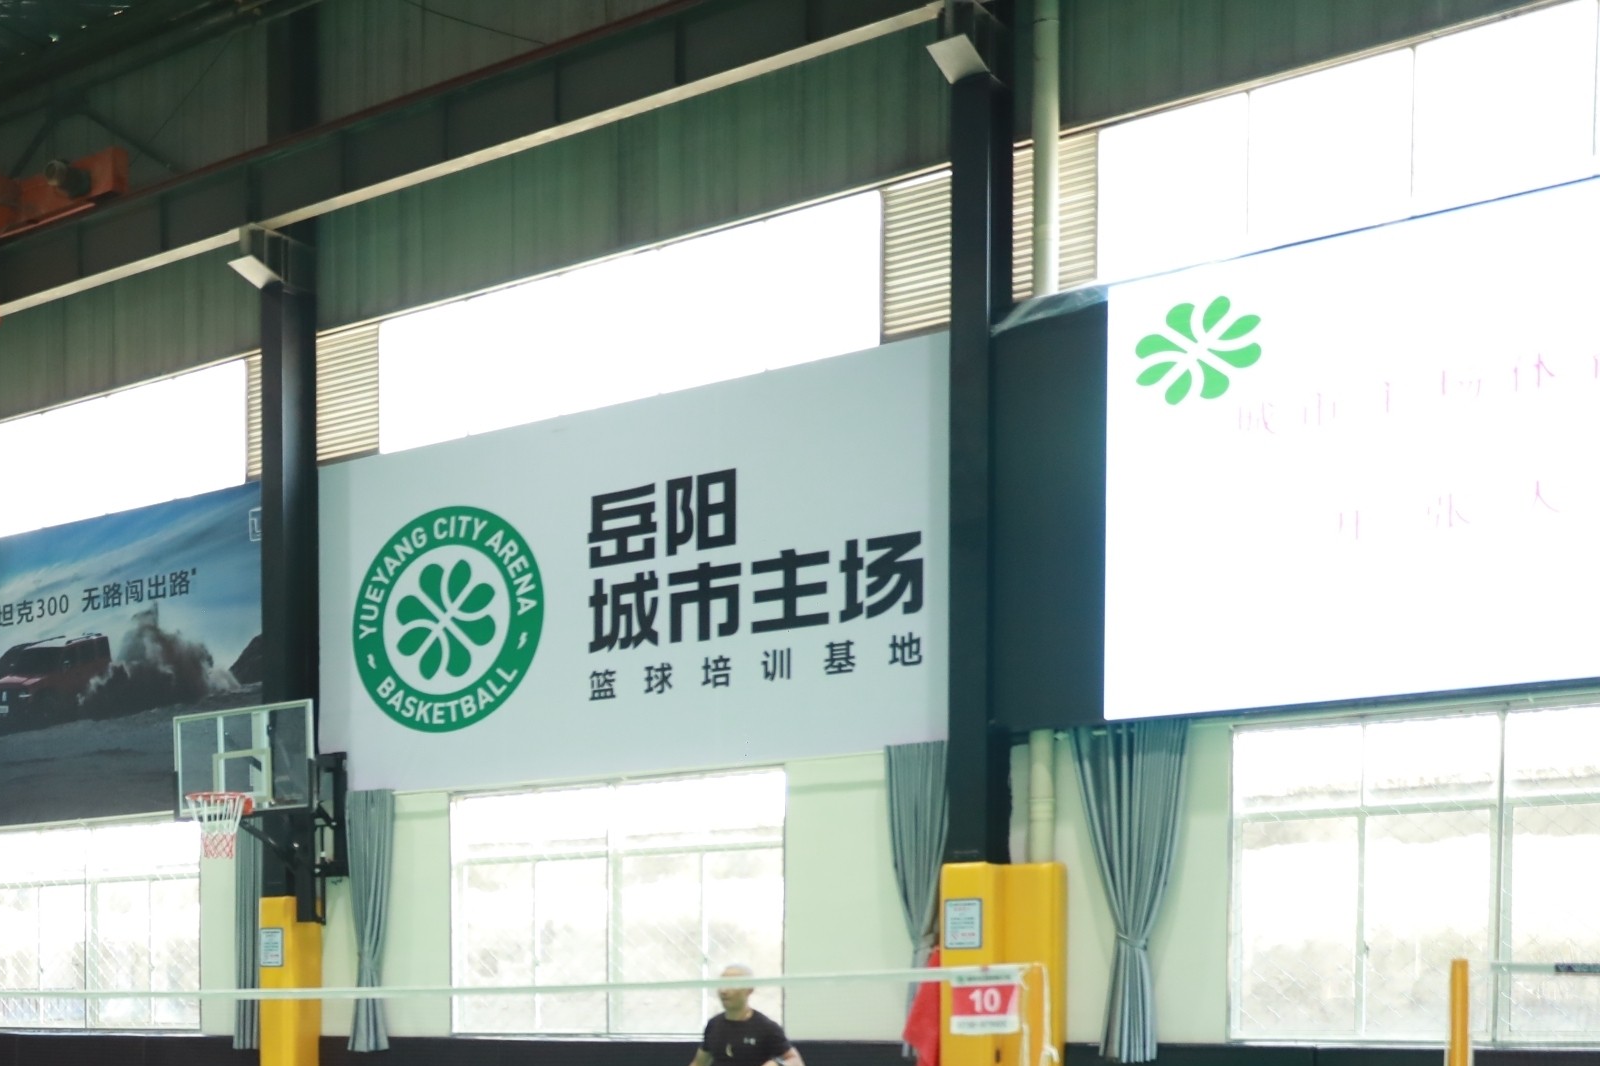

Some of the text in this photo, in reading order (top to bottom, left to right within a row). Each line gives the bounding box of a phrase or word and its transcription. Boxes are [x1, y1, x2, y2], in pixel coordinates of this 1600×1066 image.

[587, 467, 737, 569] 岳阳
[358, 514, 539, 640] YUEYANG CITY ARENA
[588, 530, 925, 654] 城市主场
[375, 666, 519, 725] BASKETBALL
[588, 631, 925, 702] 篮球培训基地
[969, 987, 1002, 1013] 10
